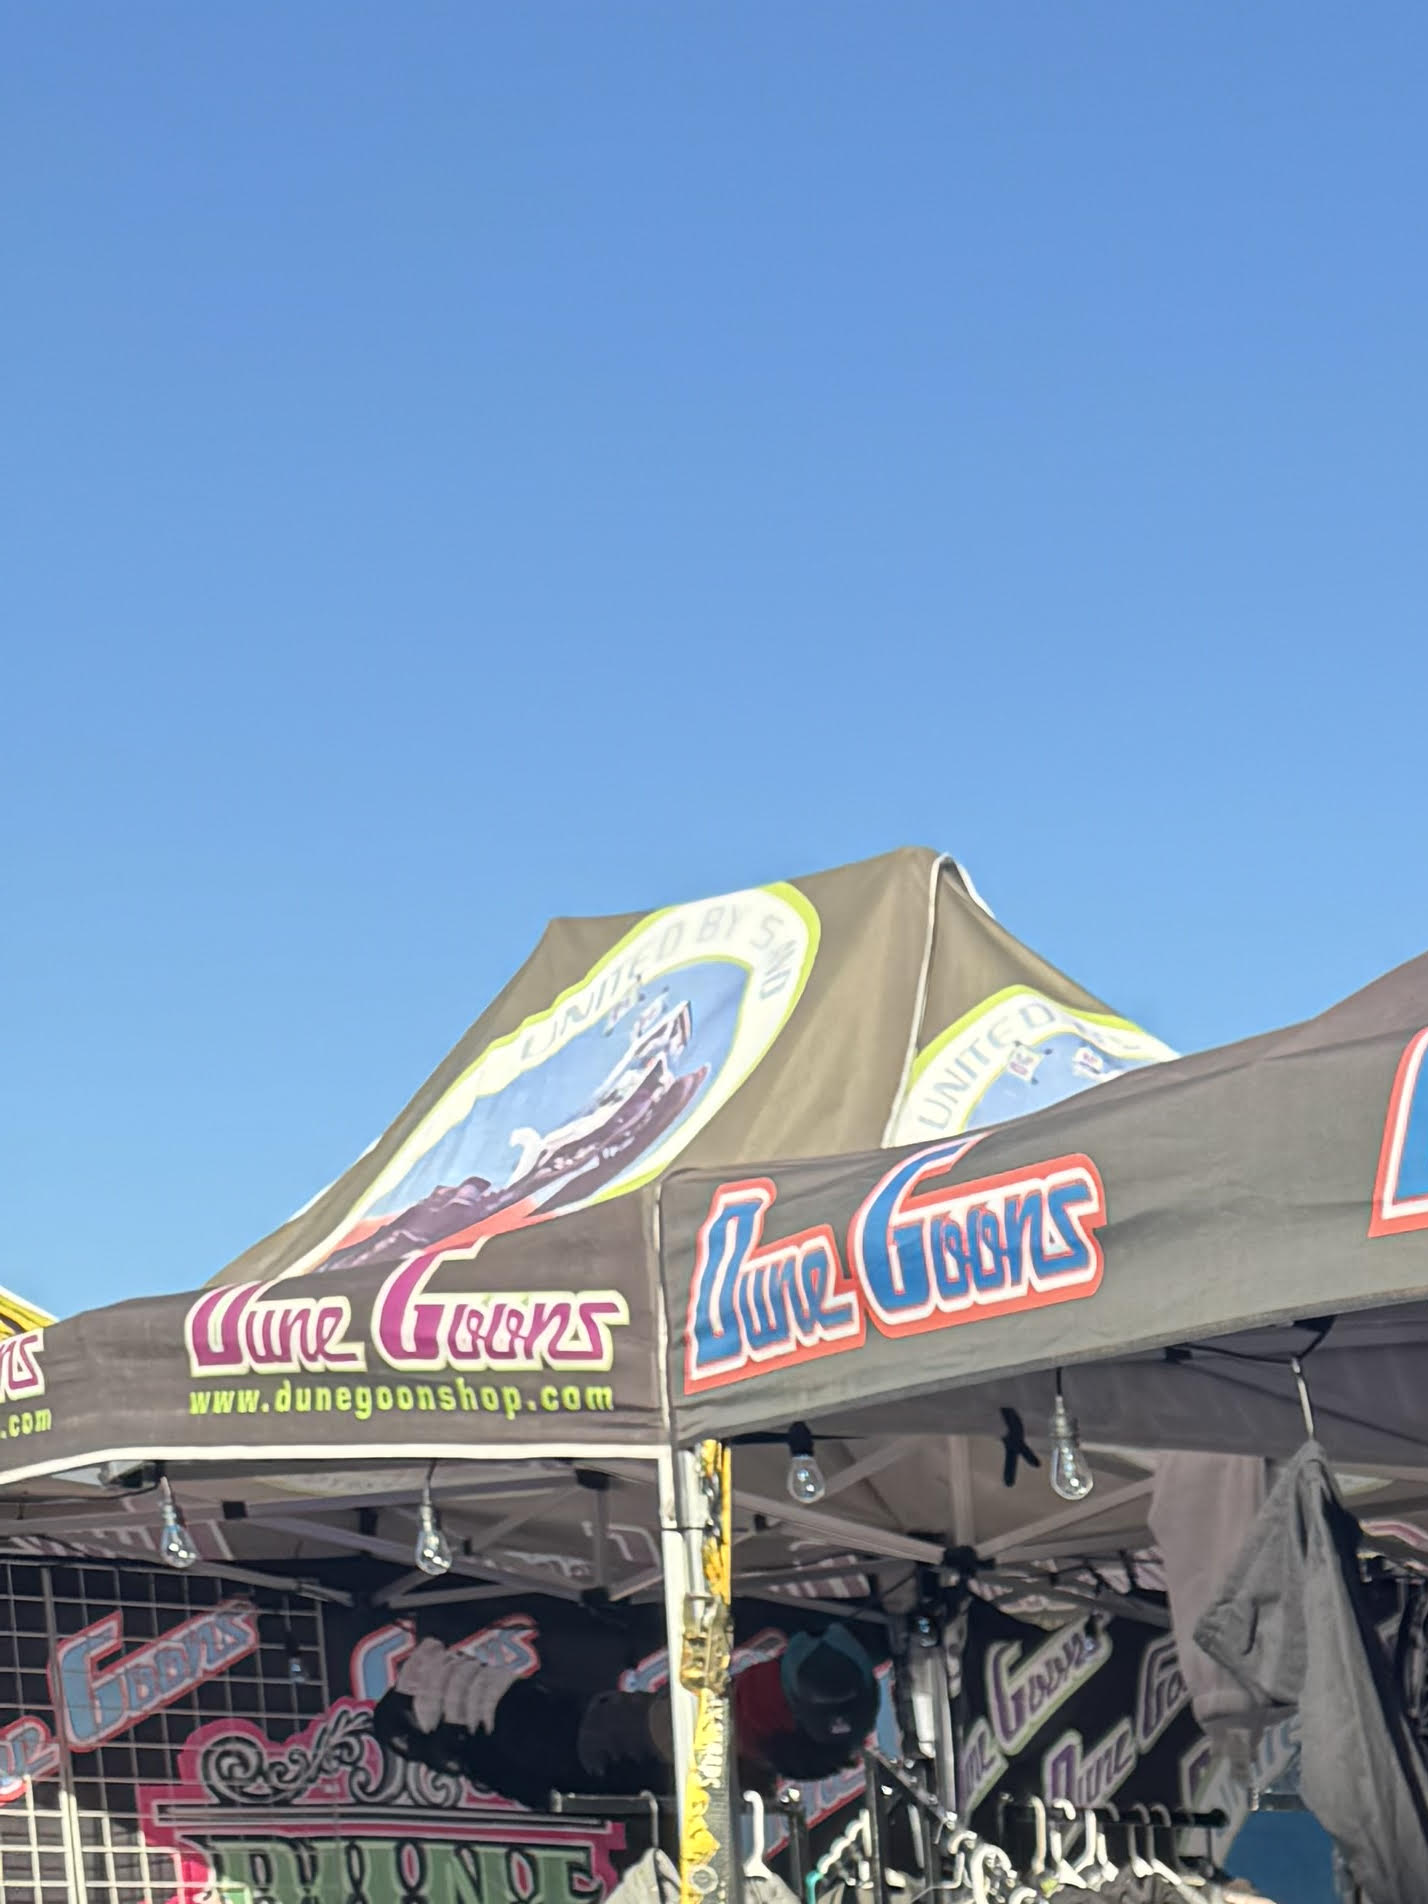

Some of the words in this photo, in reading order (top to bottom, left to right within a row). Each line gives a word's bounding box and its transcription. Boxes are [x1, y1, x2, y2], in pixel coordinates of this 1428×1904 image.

[187, 1281, 366, 1375] Dune
[372, 1236, 628, 1373] Goons
[689, 1180, 860, 1392] Dune
[853, 1137, 1104, 1334] Goons
[190, 1377, 615, 1420] www.dunegoonshop.com
